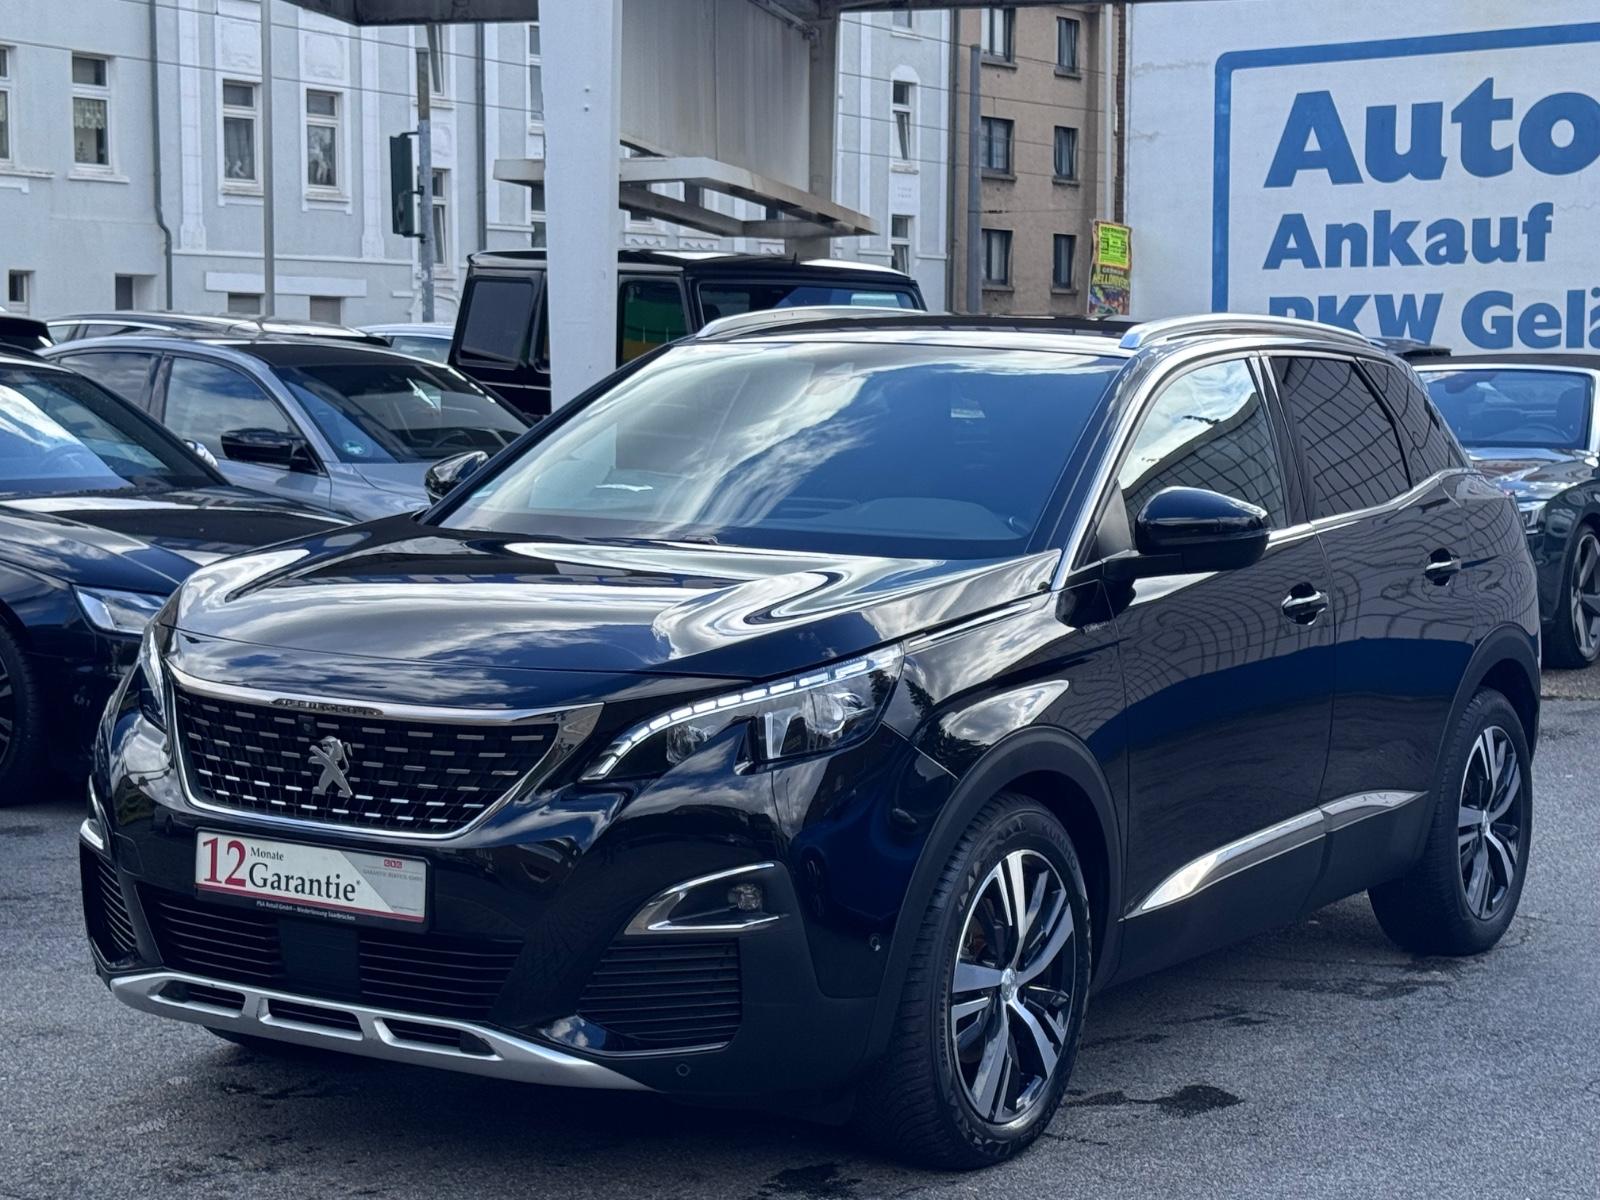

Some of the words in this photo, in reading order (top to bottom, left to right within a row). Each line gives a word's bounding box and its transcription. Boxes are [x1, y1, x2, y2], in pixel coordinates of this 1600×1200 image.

[1263, 77, 1600, 188] Auto
[1262, 202, 1554, 270] Ankauf
[1461, 287, 1600, 350] Gel
[203, 837, 247, 888] 12
[250, 846, 284, 861] Monate
